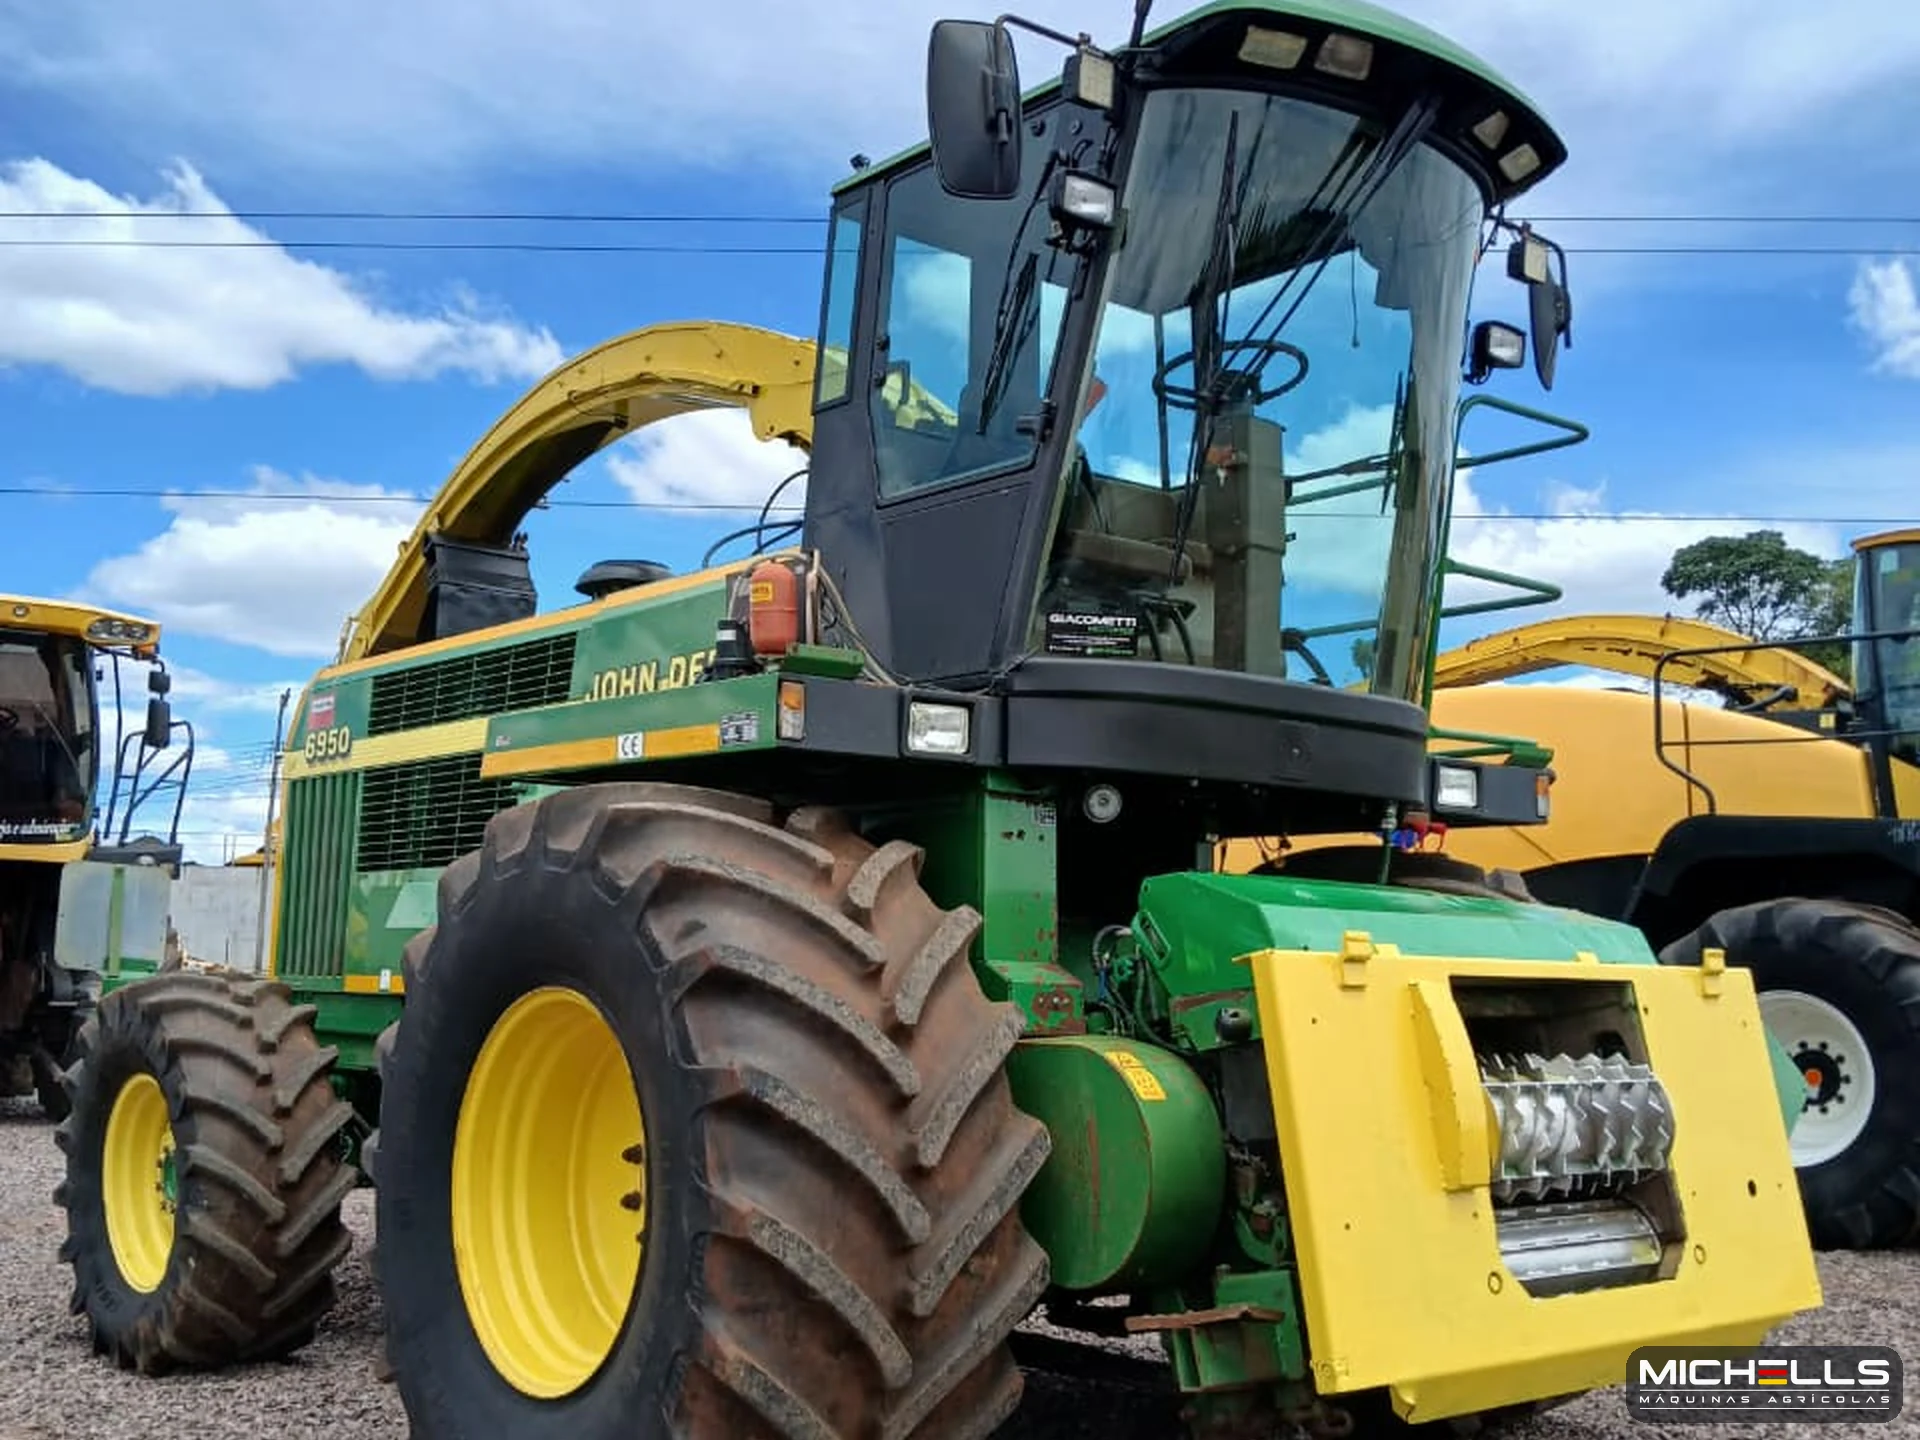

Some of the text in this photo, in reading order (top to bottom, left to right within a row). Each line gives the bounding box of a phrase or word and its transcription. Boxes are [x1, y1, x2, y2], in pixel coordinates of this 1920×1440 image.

[1049, 613, 1137, 627] GIACOMETTI
[585, 661, 658, 701] JOHN
[305, 725, 351, 762] 6950
[621, 734, 640, 757] CE
